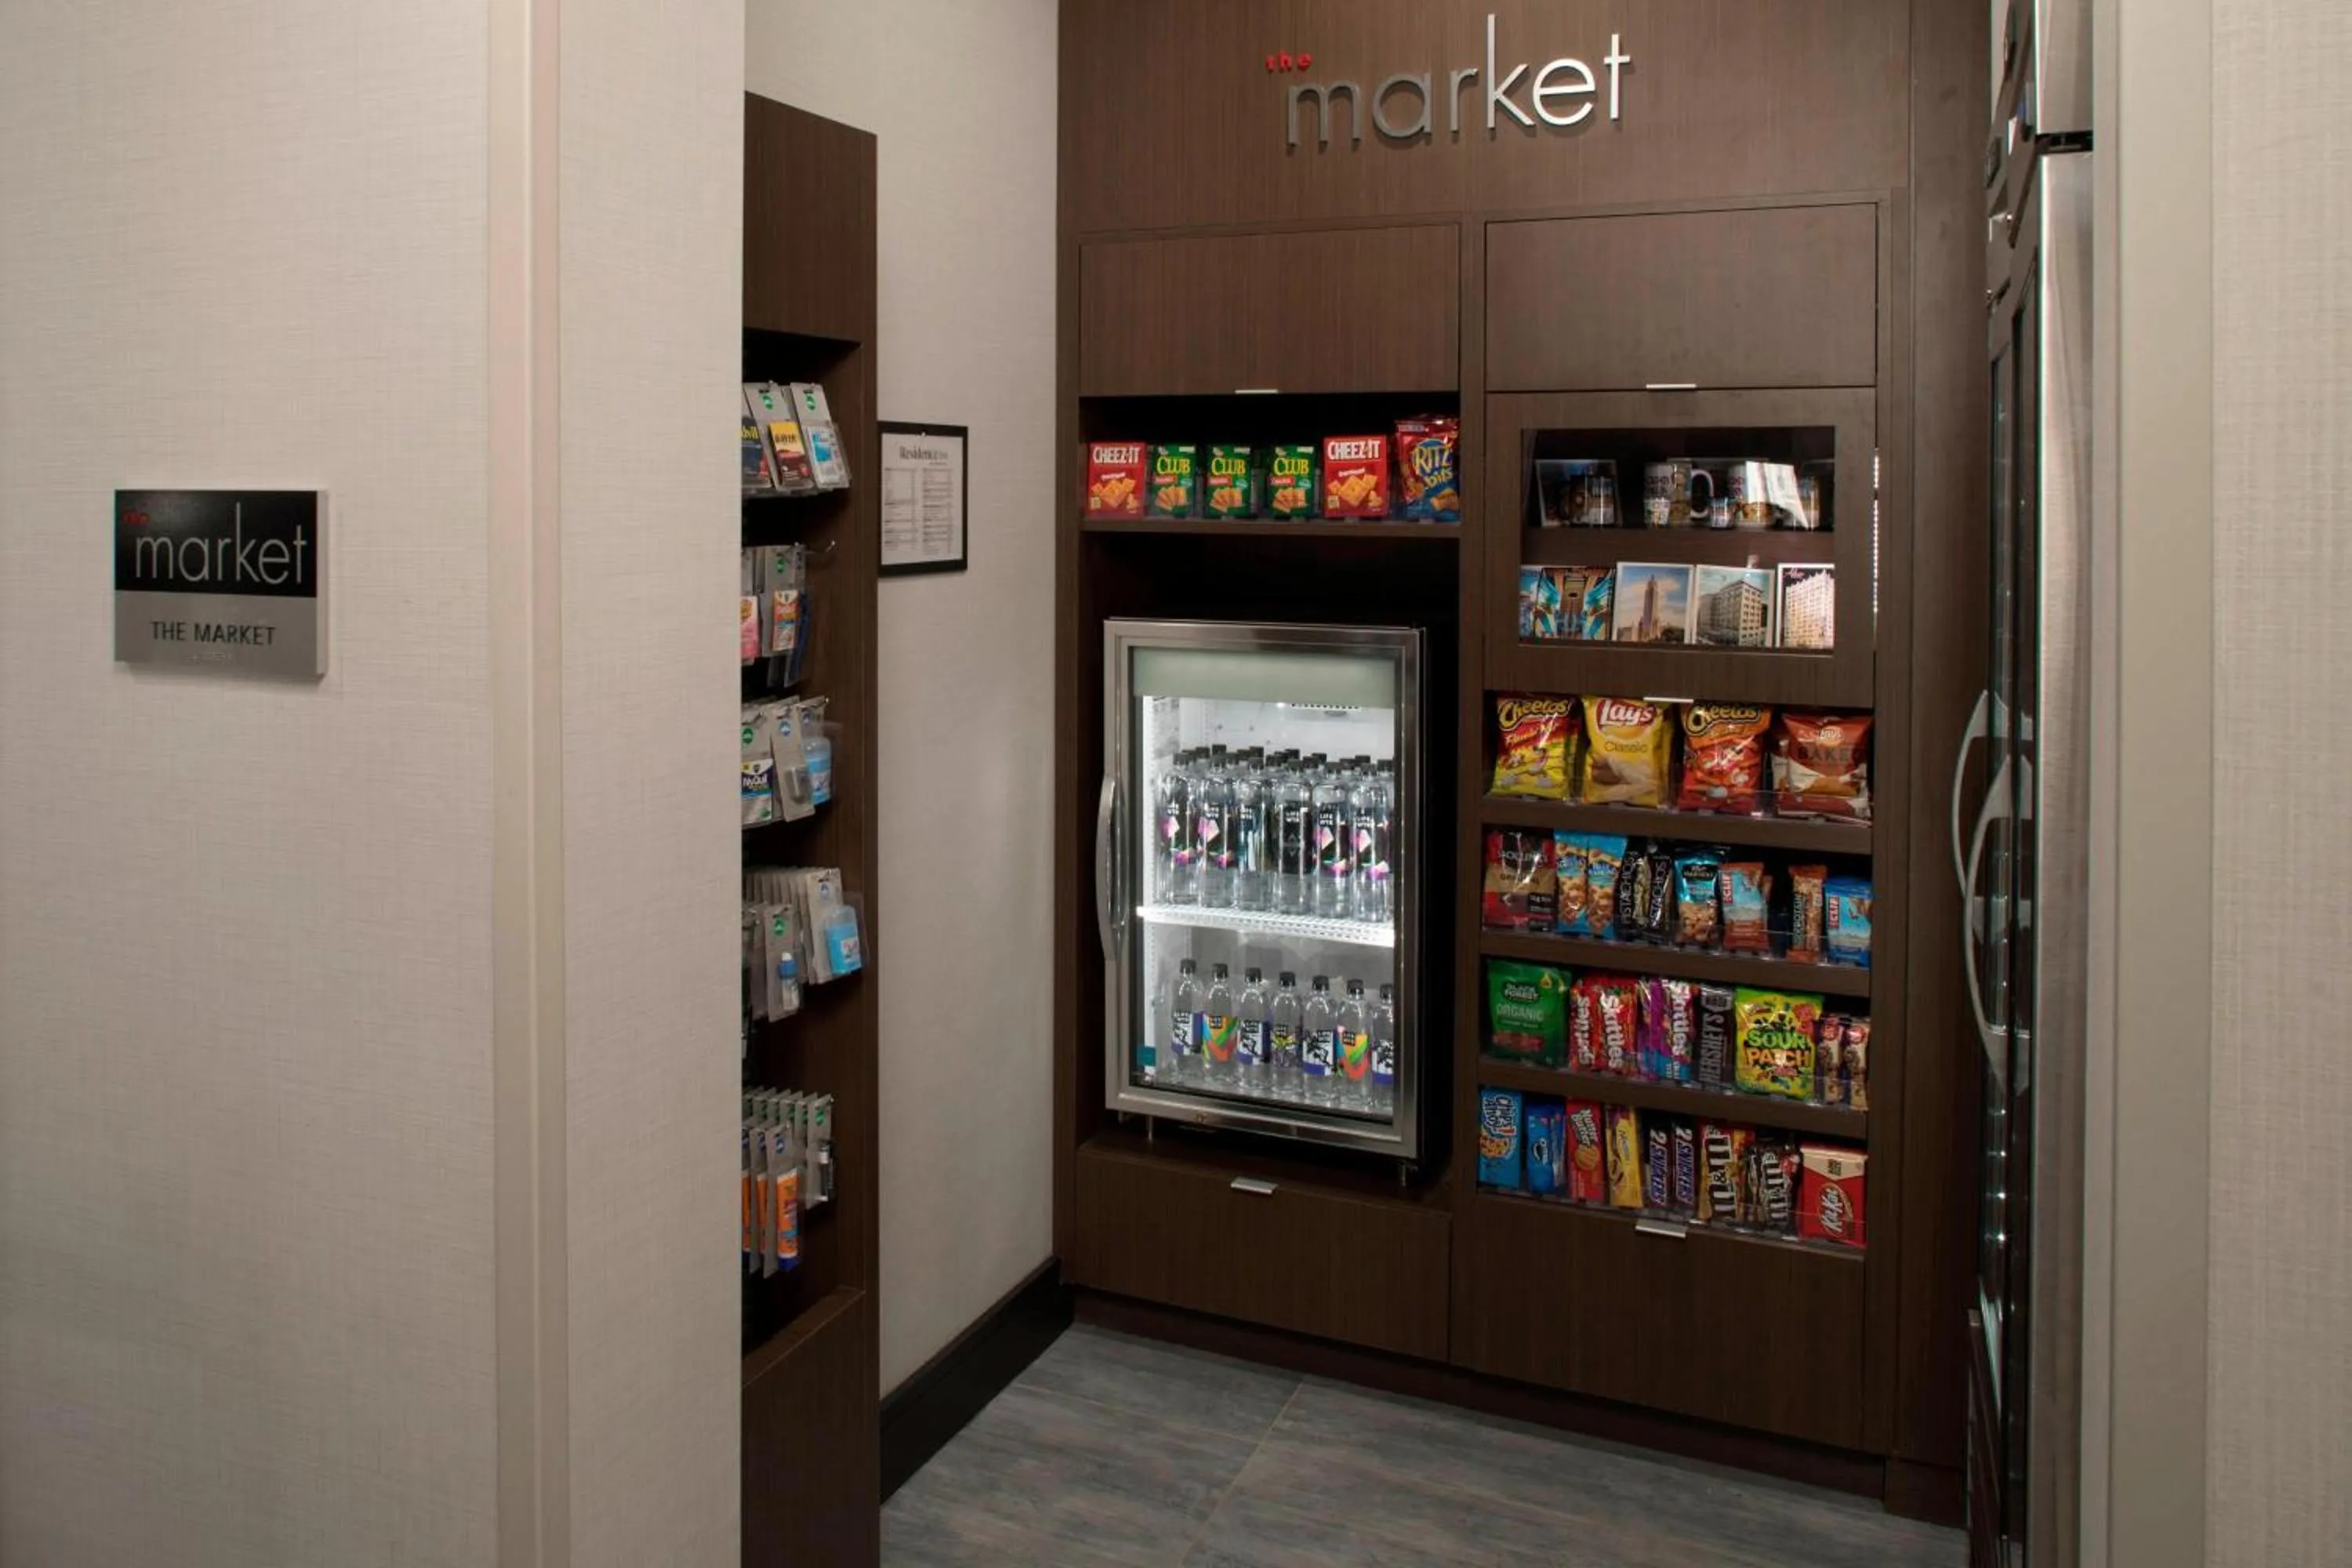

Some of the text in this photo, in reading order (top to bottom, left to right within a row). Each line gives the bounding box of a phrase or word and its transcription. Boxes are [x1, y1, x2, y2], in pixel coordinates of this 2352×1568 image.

[1265, 50, 1312, 71] the
[1287, 13, 1631, 146] market
[1327, 439, 1381, 460] CHEEZ-IT
[1414, 445, 1452, 475] RITZ
[136, 502, 307, 584] market
[151, 621, 276, 645] THE MARKET
[1500, 699, 1567, 730] Cheetos
[1688, 705, 1758, 733] Cheetos
[1496, 1003, 1544, 1022] ORGANIC
[1699, 1013, 1725, 1083] HERSHEY'S
[1748, 1028, 1806, 1049] SOUR
[1746, 1047, 1810, 1067] PATCH
